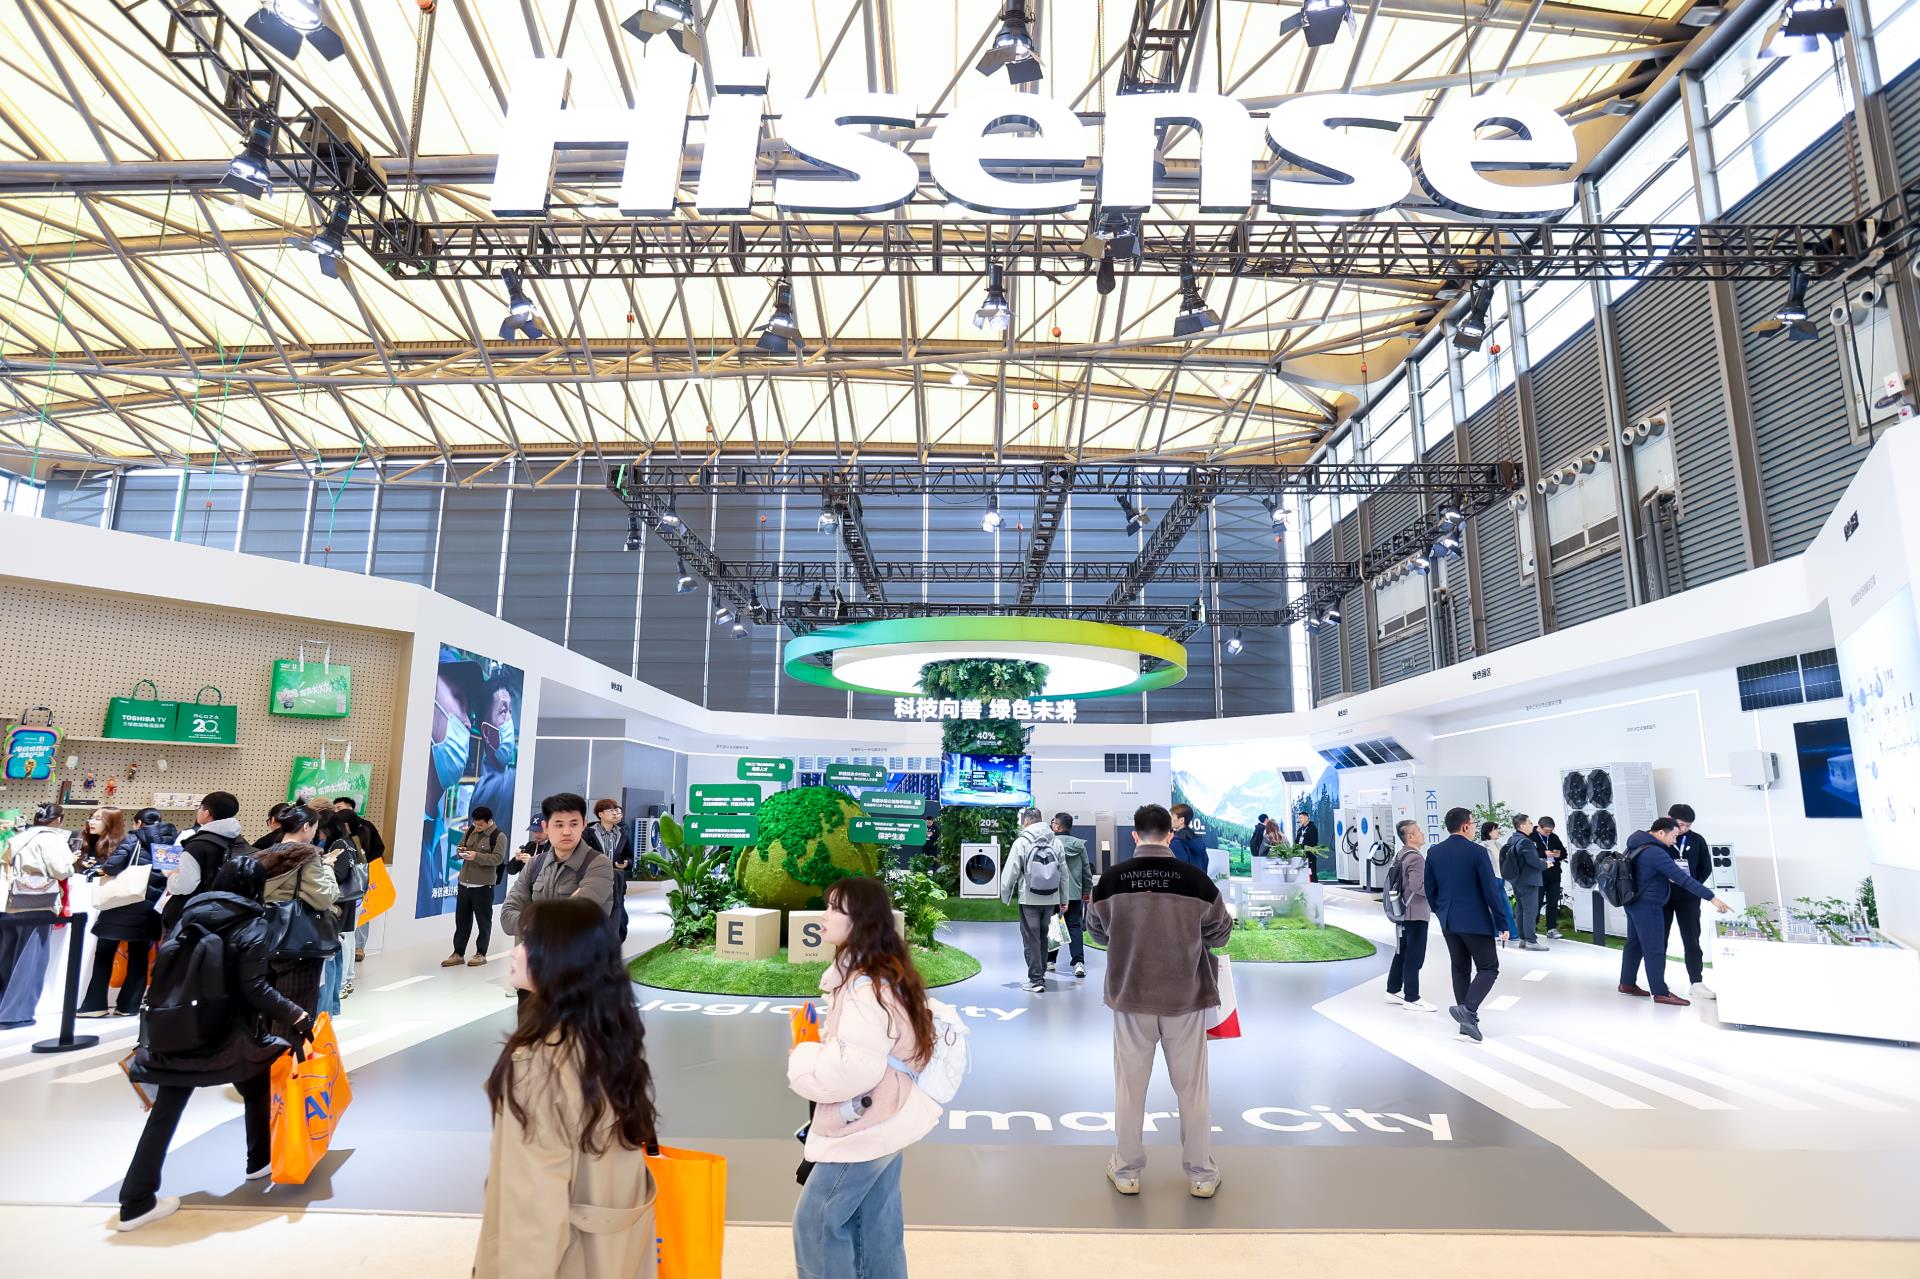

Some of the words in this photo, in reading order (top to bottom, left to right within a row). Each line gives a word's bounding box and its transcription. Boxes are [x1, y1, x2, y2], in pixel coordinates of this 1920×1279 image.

[491, 55, 1578, 219] Hisense
[122, 714, 156, 723] TOSHIBA
[894, 698, 982, 720] 科技向善
[989, 699, 1077, 722] 绿色未来
[976, 731, 996, 740] 40%
[980, 818, 1000, 828] 20%
[1120, 869, 1181, 881] DANGEROUS
[1131, 879, 1170, 889] PEOPLE
[727, 920, 744, 946] E
[802, 922, 823, 948] S
[1241, 1105, 1453, 1141] City
